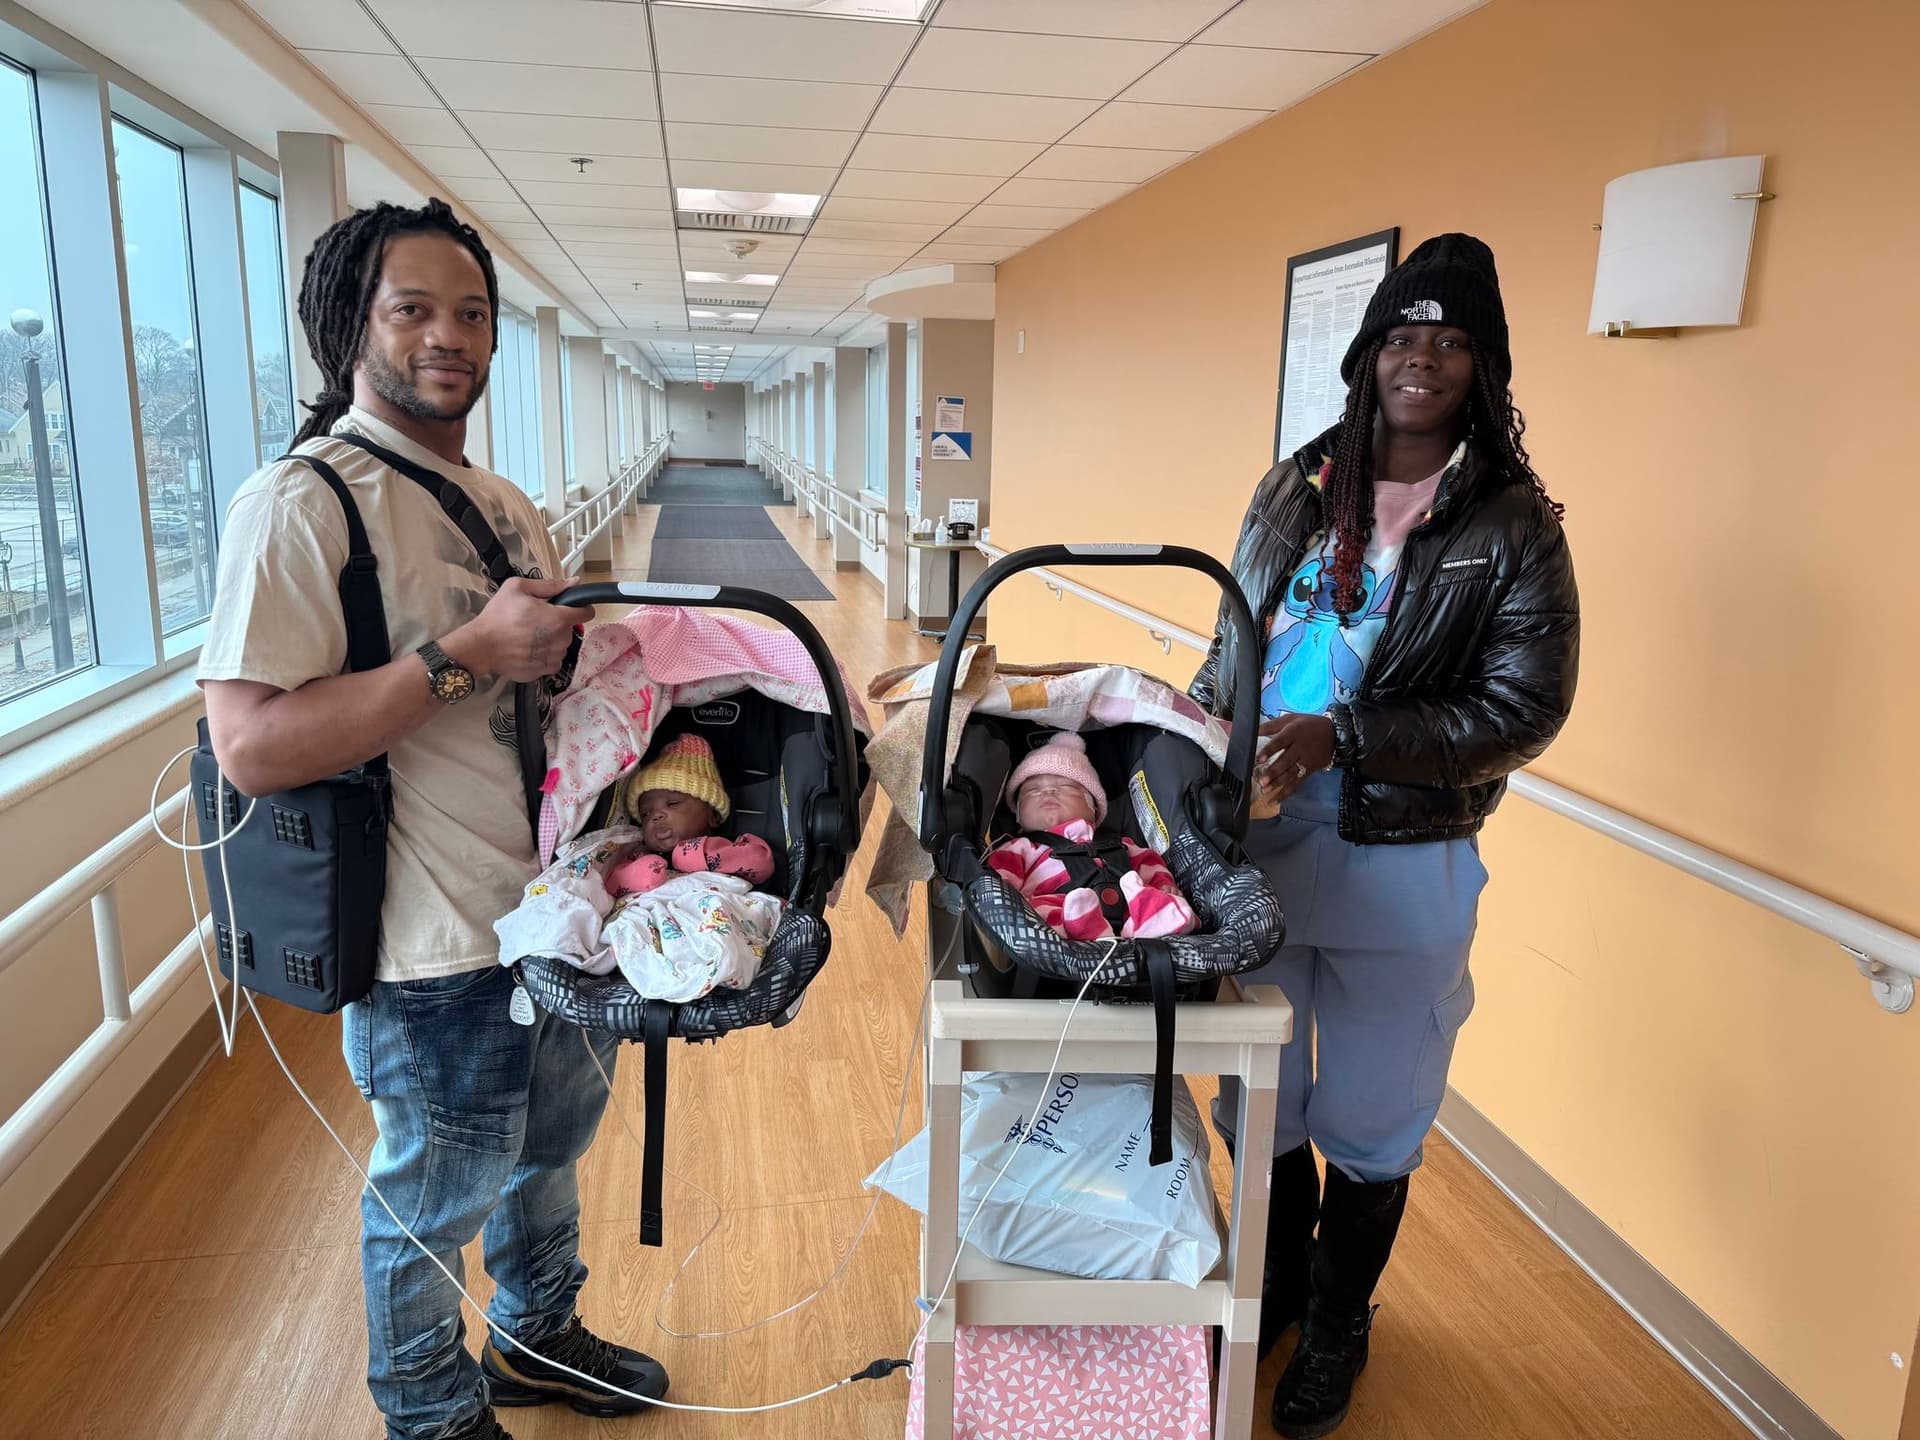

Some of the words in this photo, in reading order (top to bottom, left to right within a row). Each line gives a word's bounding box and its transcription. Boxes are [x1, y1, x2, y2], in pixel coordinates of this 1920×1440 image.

[1414, 300, 1430, 308] THE
[1401, 307, 1430, 315] NORTH
[1408, 313, 1430, 321] FACE
[1442, 559, 1471, 569] MEMBERS
[1036, 1072, 1080, 1137] PERSO
[1115, 1133, 1142, 1172] NAME
[1166, 1157, 1192, 1200] ROOM
